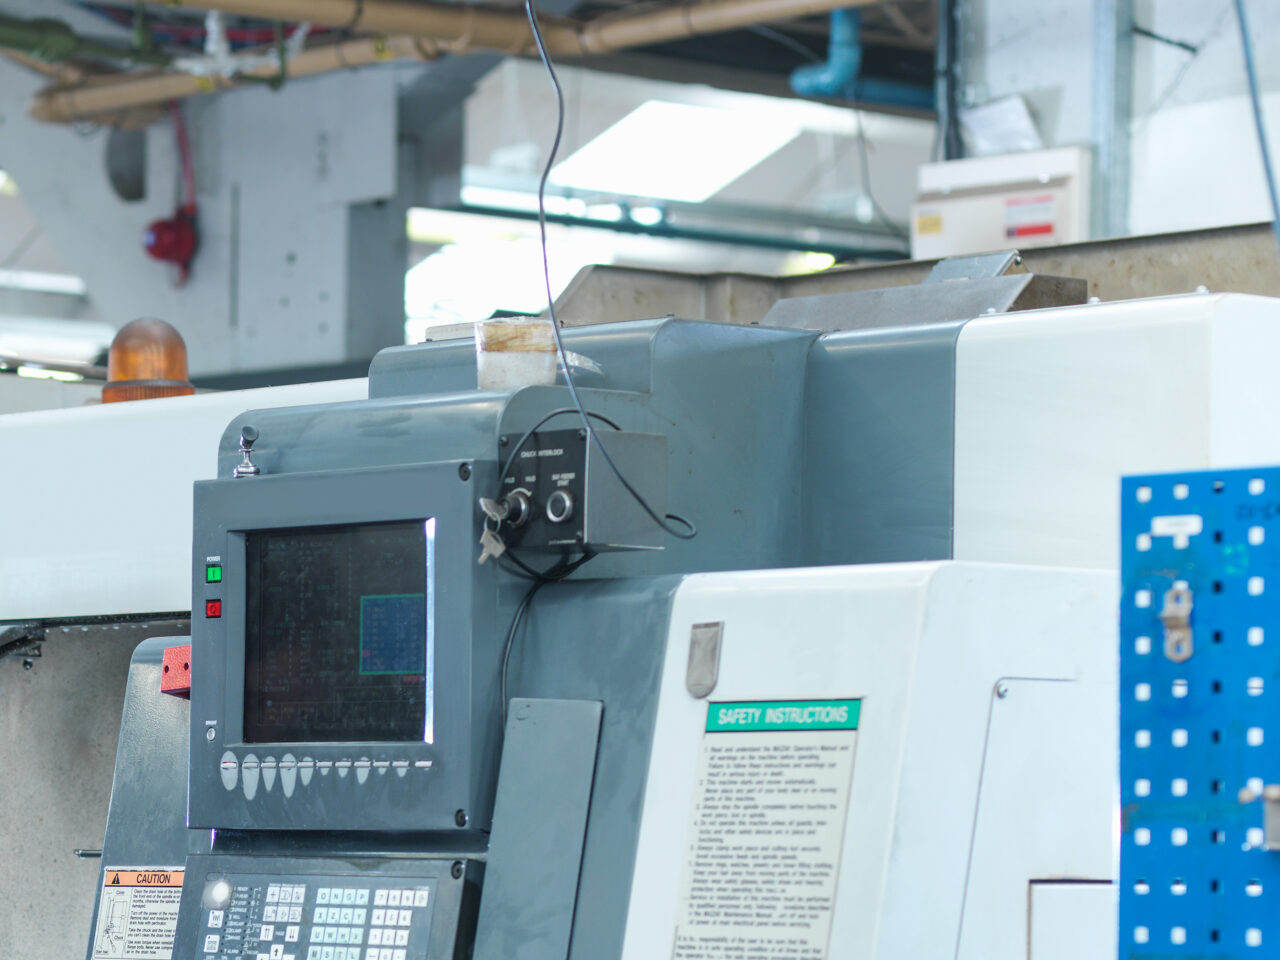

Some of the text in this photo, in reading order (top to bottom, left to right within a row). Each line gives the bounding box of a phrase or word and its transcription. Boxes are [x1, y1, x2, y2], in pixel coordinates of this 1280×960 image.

[718, 706, 848, 724] SAFETY INSTRUCTIONS
[137, 874, 171, 883] CAUTION
